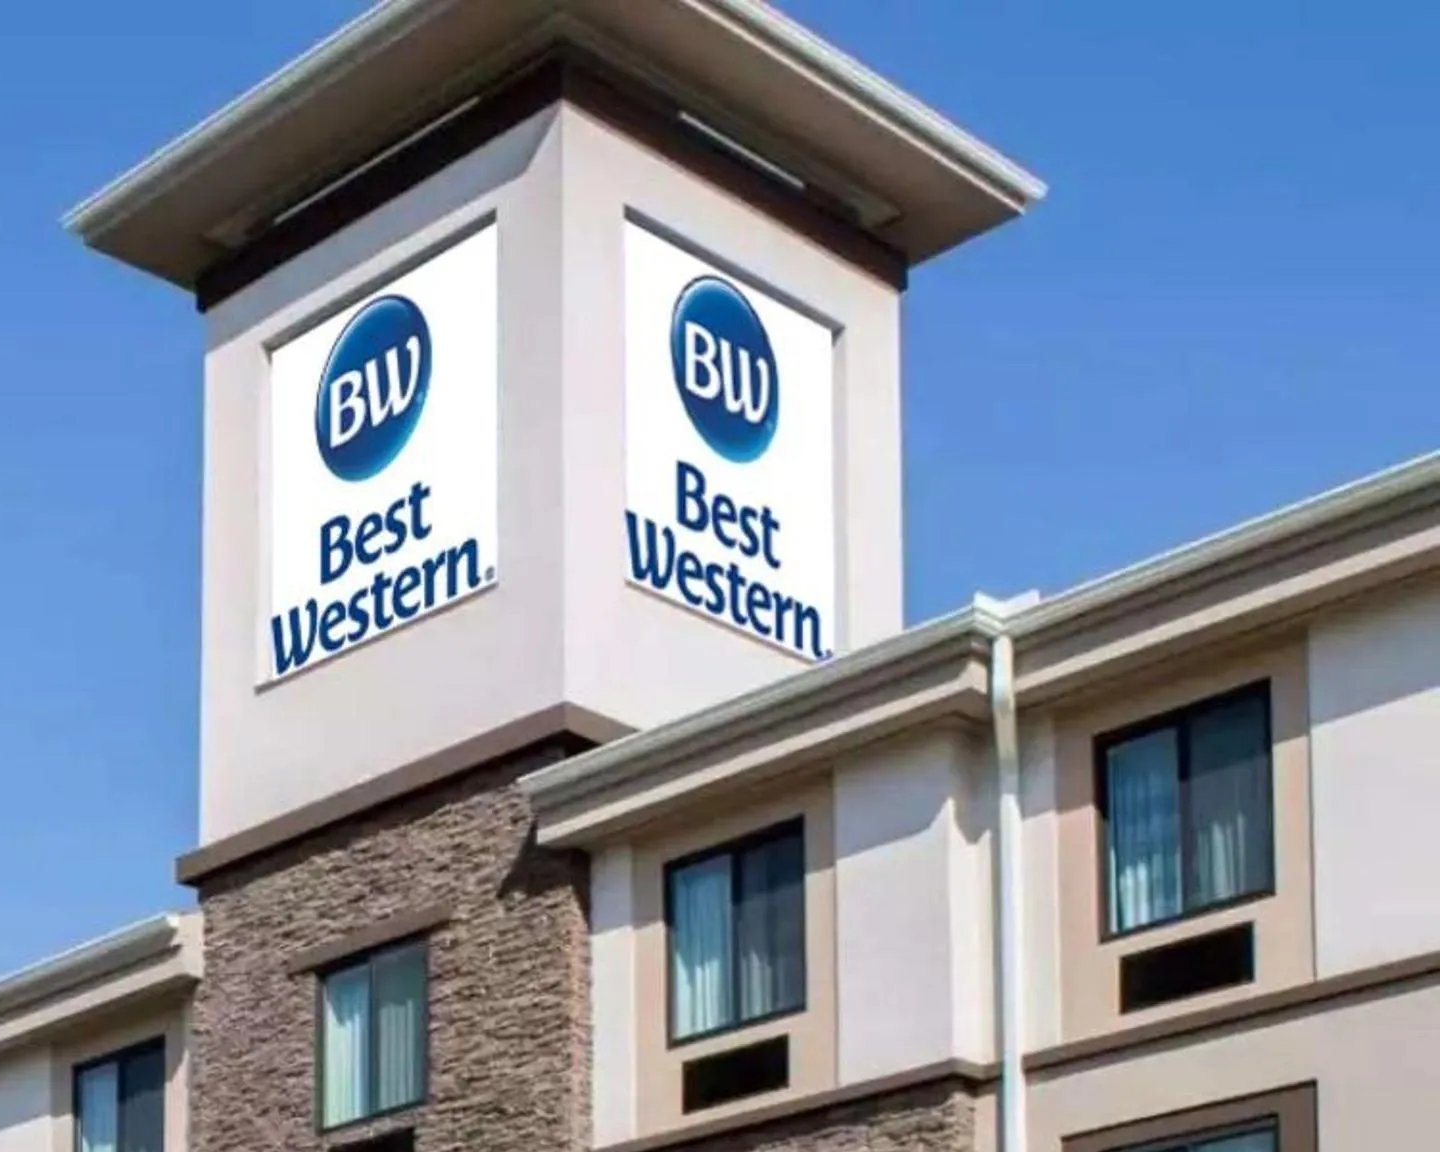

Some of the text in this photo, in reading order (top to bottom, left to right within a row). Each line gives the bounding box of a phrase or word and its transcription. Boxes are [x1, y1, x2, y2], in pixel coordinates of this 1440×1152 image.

[329, 335, 420, 447] BW
[685, 321, 769, 424] BW
[320, 482, 432, 585] Best
[676, 460, 781, 569] Best
[271, 538, 481, 675] Western
[625, 509, 824, 661] Western
